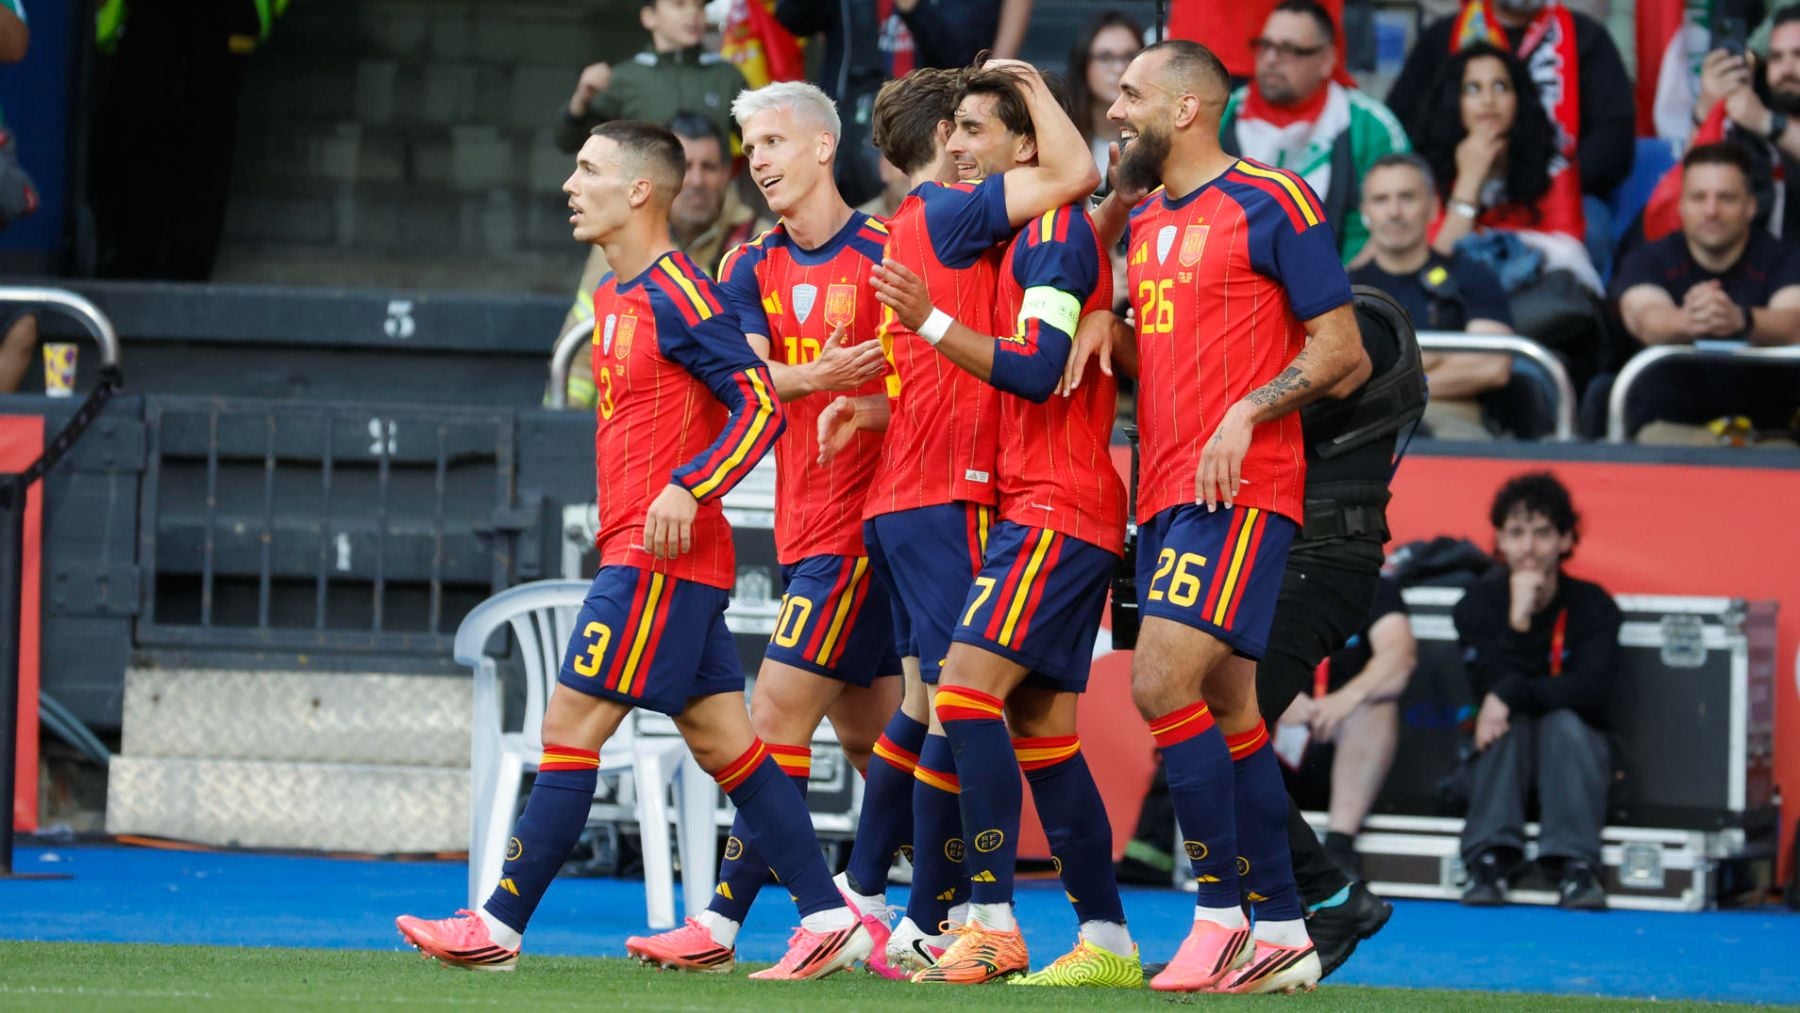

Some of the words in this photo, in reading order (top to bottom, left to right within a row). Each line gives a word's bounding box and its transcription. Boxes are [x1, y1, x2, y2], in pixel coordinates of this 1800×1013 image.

[1139, 279, 1174, 334] 26
[335, 532, 351, 570] 1
[1147, 547, 1207, 608] 26
[769, 592, 813, 649] 10
[962, 576, 997, 627] 7
[573, 621, 612, 678] 3
